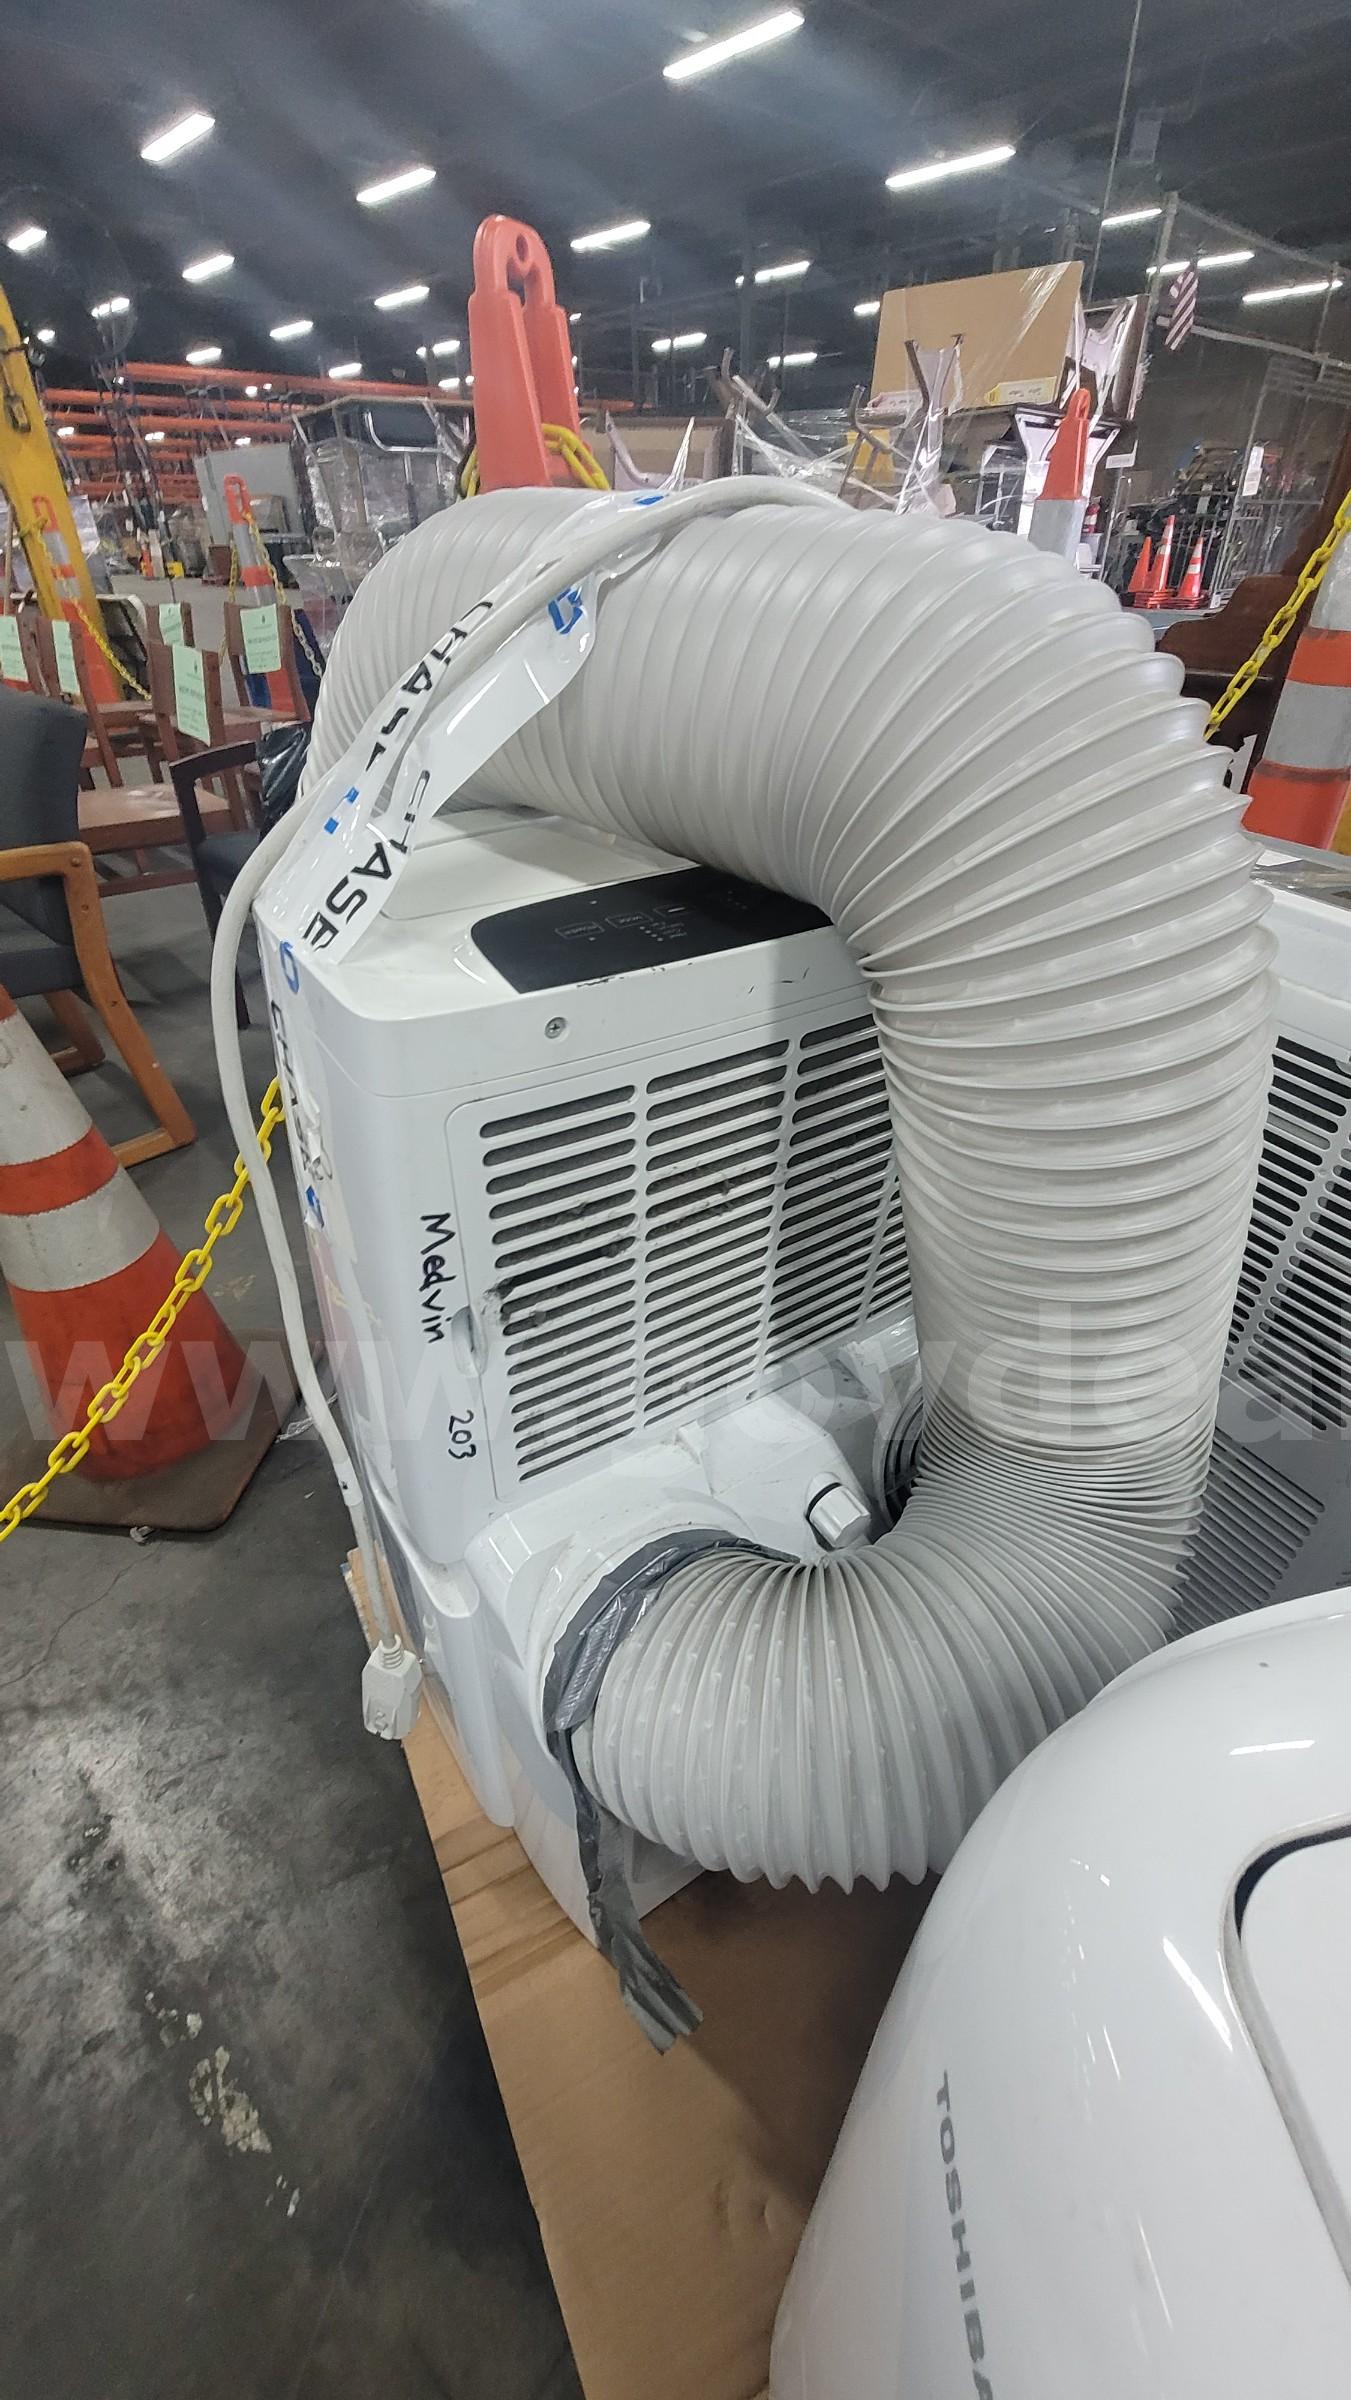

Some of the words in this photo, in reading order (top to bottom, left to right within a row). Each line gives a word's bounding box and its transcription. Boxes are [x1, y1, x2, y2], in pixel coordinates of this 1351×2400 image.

[418, 1212, 457, 1344] Medvin
[447, 1408, 477, 1460] 203
[936, 2068, 994, 2400] TOSHIBA
